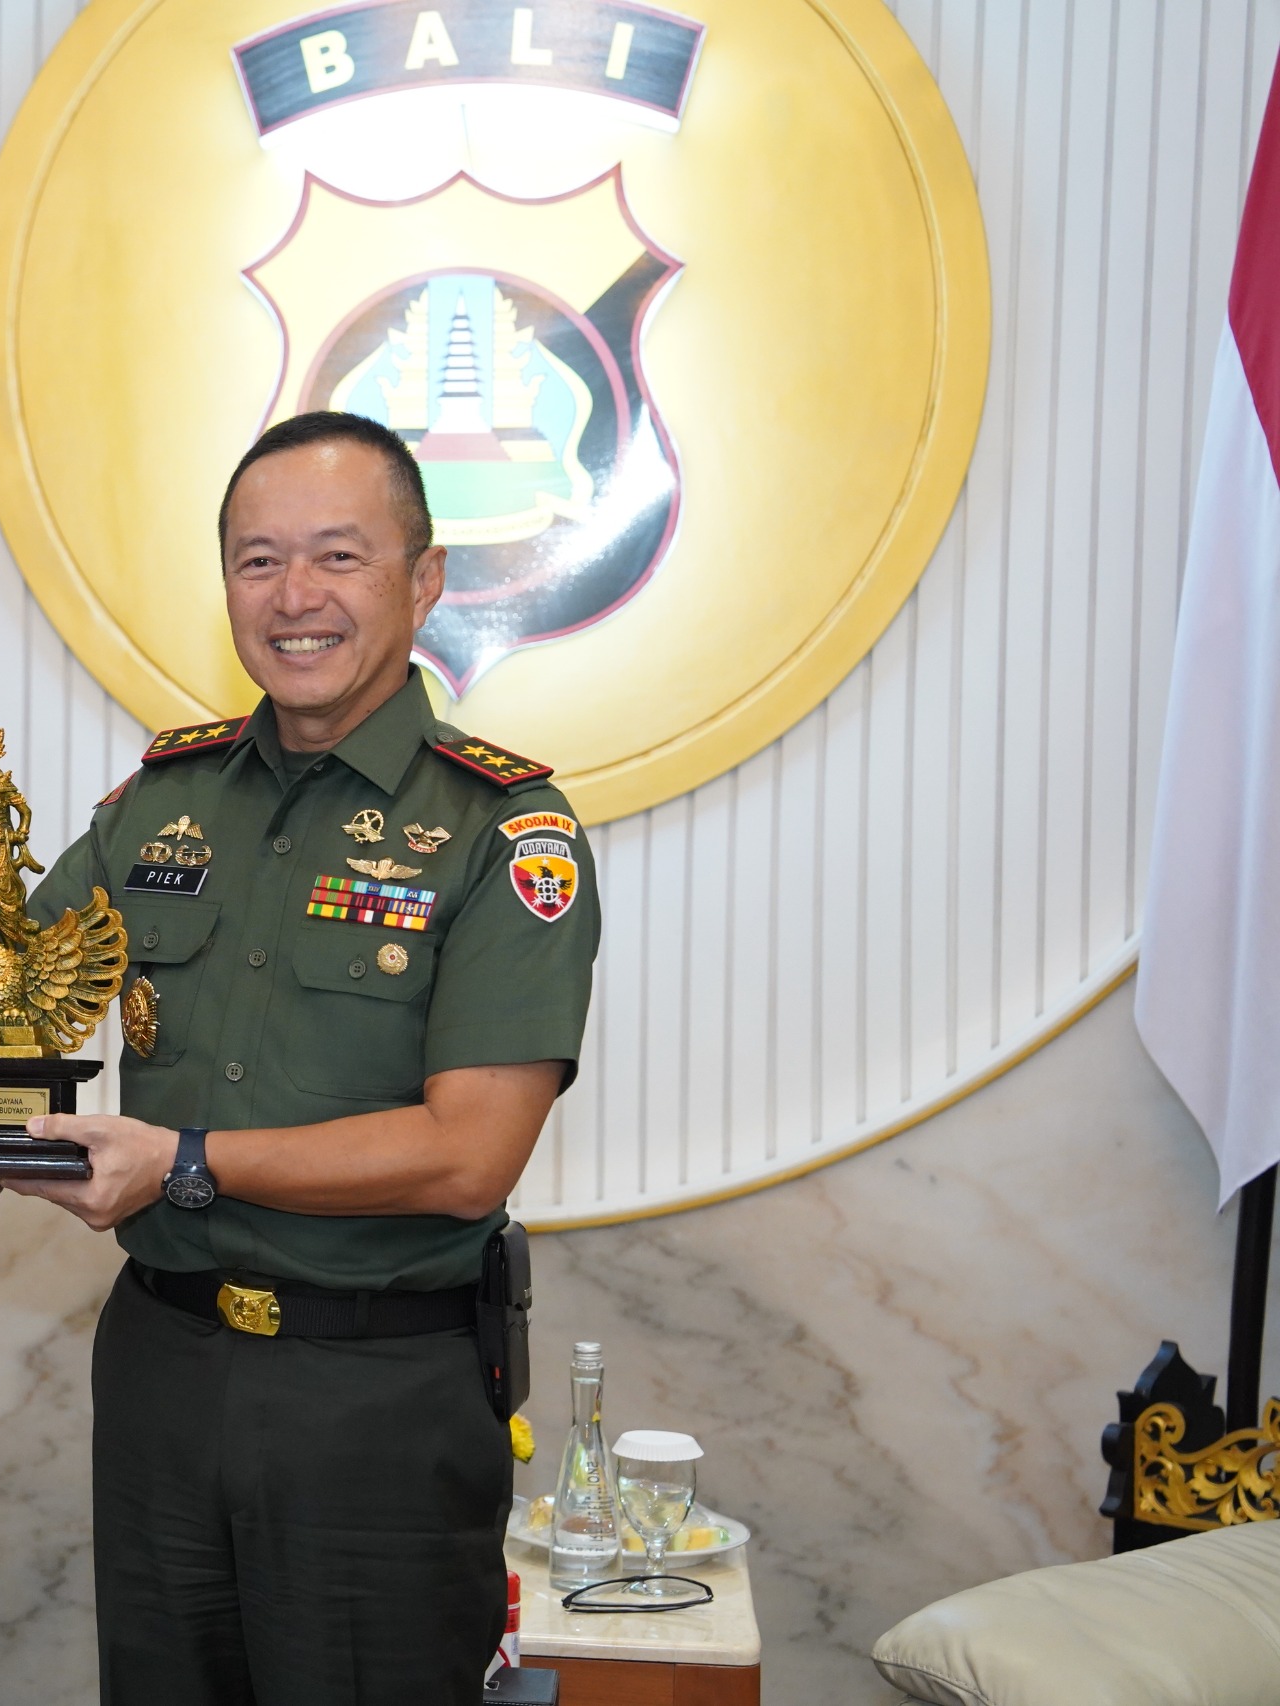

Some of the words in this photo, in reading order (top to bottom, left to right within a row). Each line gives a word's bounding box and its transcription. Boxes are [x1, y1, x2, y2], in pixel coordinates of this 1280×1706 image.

[300, 8, 634, 93] BALI
[499, 764, 539, 777] TNI
[508, 815, 559, 834] SKODAM
[562, 820, 572, 833] IX
[521, 842, 566, 855] UDAYANA
[146, 871, 184, 884] PIEK
[0, 1107, 33, 1115] BUDYAKTO
